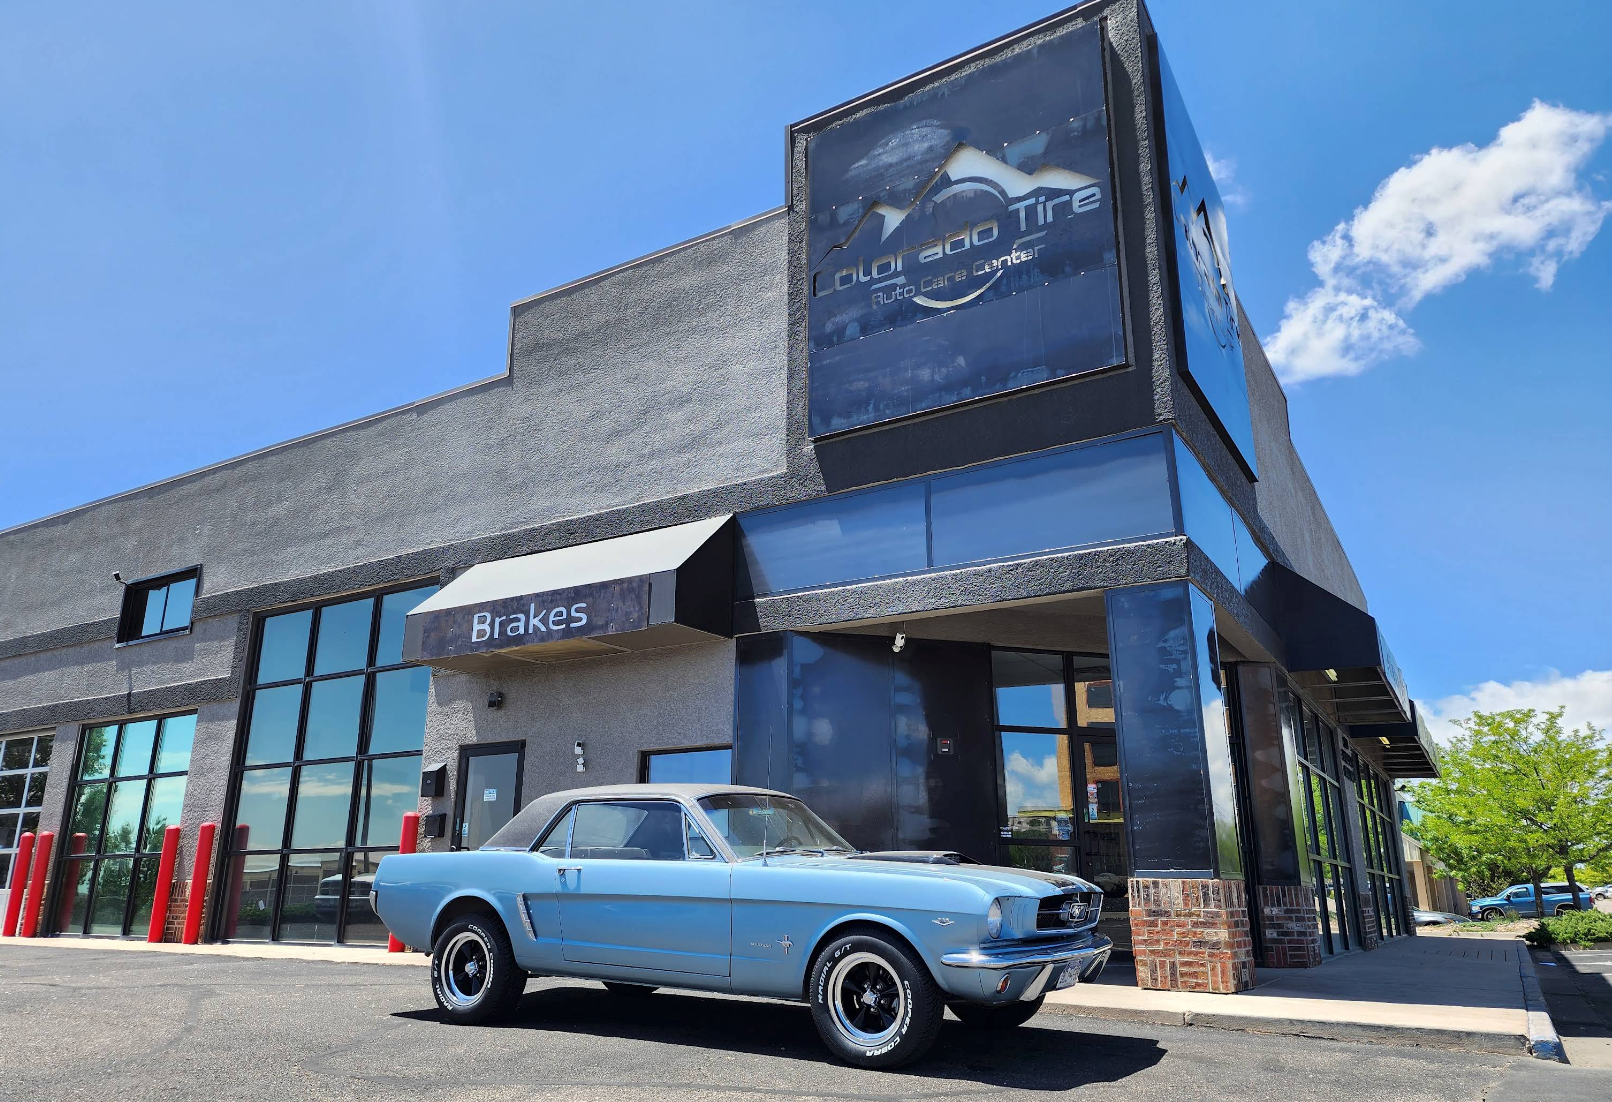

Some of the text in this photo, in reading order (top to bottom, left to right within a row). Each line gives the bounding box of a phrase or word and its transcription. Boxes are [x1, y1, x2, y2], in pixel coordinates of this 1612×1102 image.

[812, 185, 1102, 299] Colorado Tire
[871, 244, 1046, 309] Auto Care Center
[471, 602, 588, 643] Brakes
[468, 924, 491, 949] COOPER
[435, 981, 454, 1011] RADIAL
[818, 943, 852, 1004] RADIAL G/T
[866, 980, 913, 1057] COOPER COBRA
